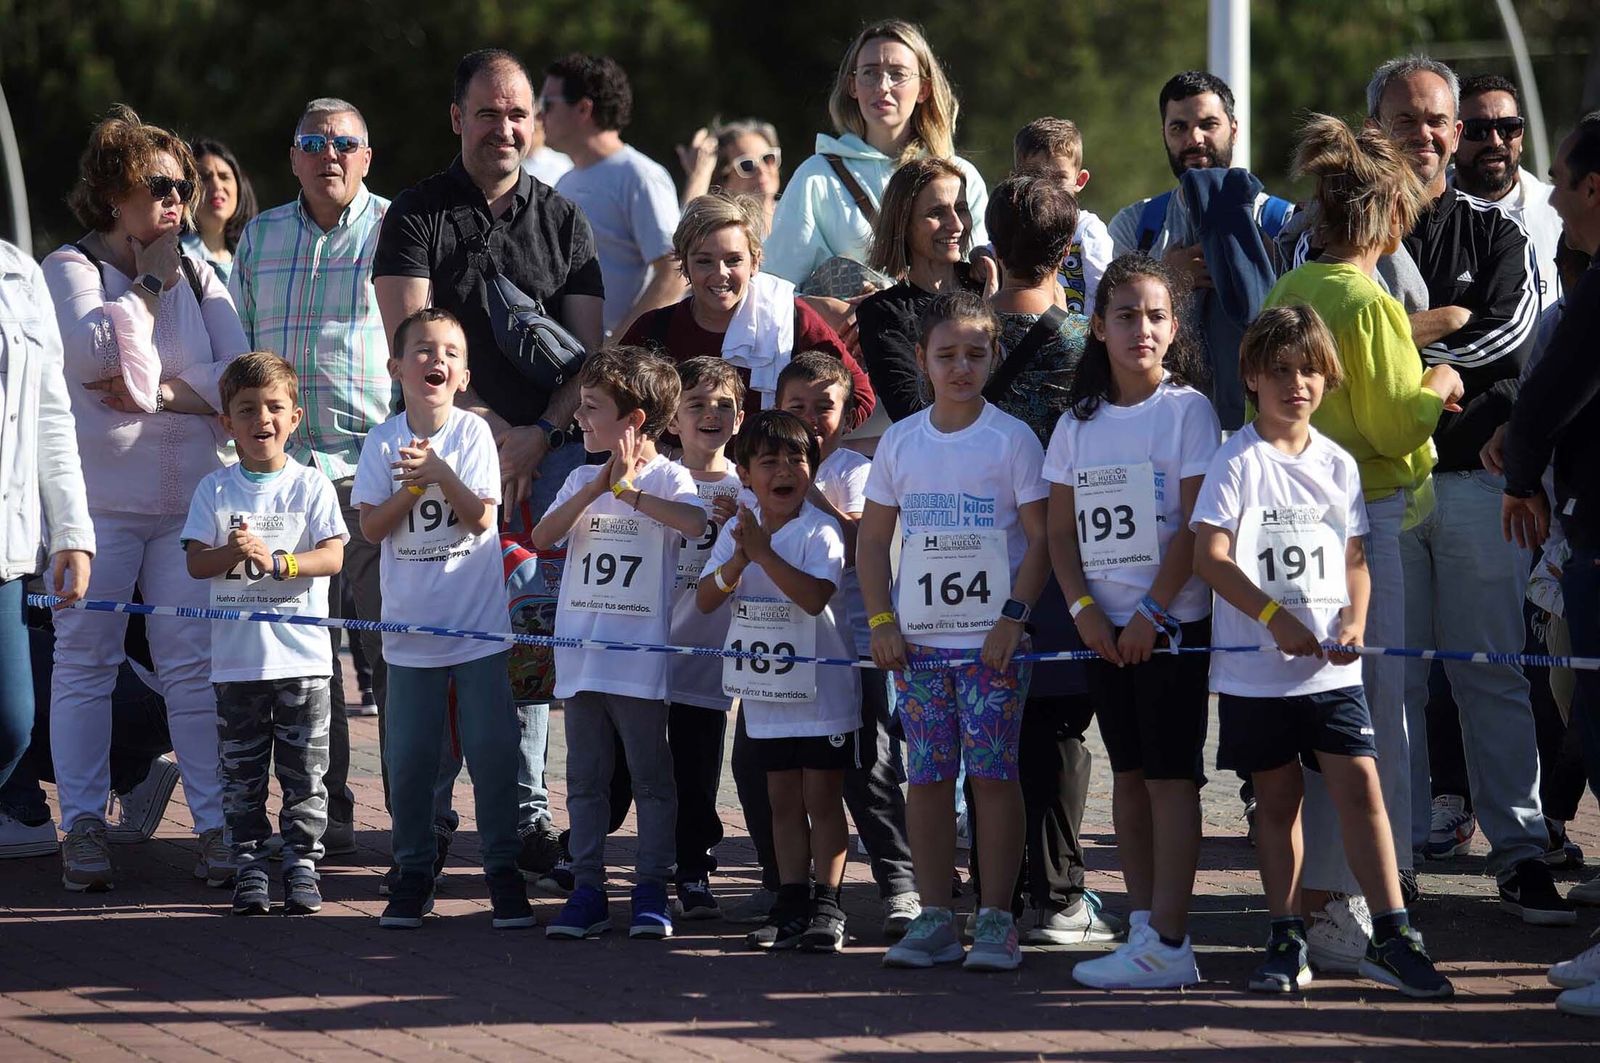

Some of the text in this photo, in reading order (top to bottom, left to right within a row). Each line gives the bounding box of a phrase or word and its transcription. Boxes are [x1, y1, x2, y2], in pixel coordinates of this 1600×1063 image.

[1098, 474, 1127, 482] HUELVA
[963, 501, 995, 514] kilos
[256, 520, 285, 528] HUELVA
[963, 514, 994, 527] x km
[1078, 504, 1137, 544] 193
[610, 524, 639, 532] HUELVA
[1106, 556, 1118, 565] tus
[1119, 553, 1153, 564] sentidos.
[1257, 545, 1326, 582] 191
[581, 552, 644, 588] 197
[917, 570, 992, 607] 164
[216, 594, 236, 603] Huelva
[269, 595, 302, 604] sentidos.
[604, 601, 616, 611] tus
[617, 603, 652, 613] sentidos.
[760, 611, 790, 619] HUELVA
[906, 622, 934, 631] Huelva
[956, 620, 969, 629] tus
[969, 618, 999, 629] sentido
[730, 639, 796, 676] 189
[761, 689, 774, 698] tus
[774, 690, 809, 699] sentidos.
